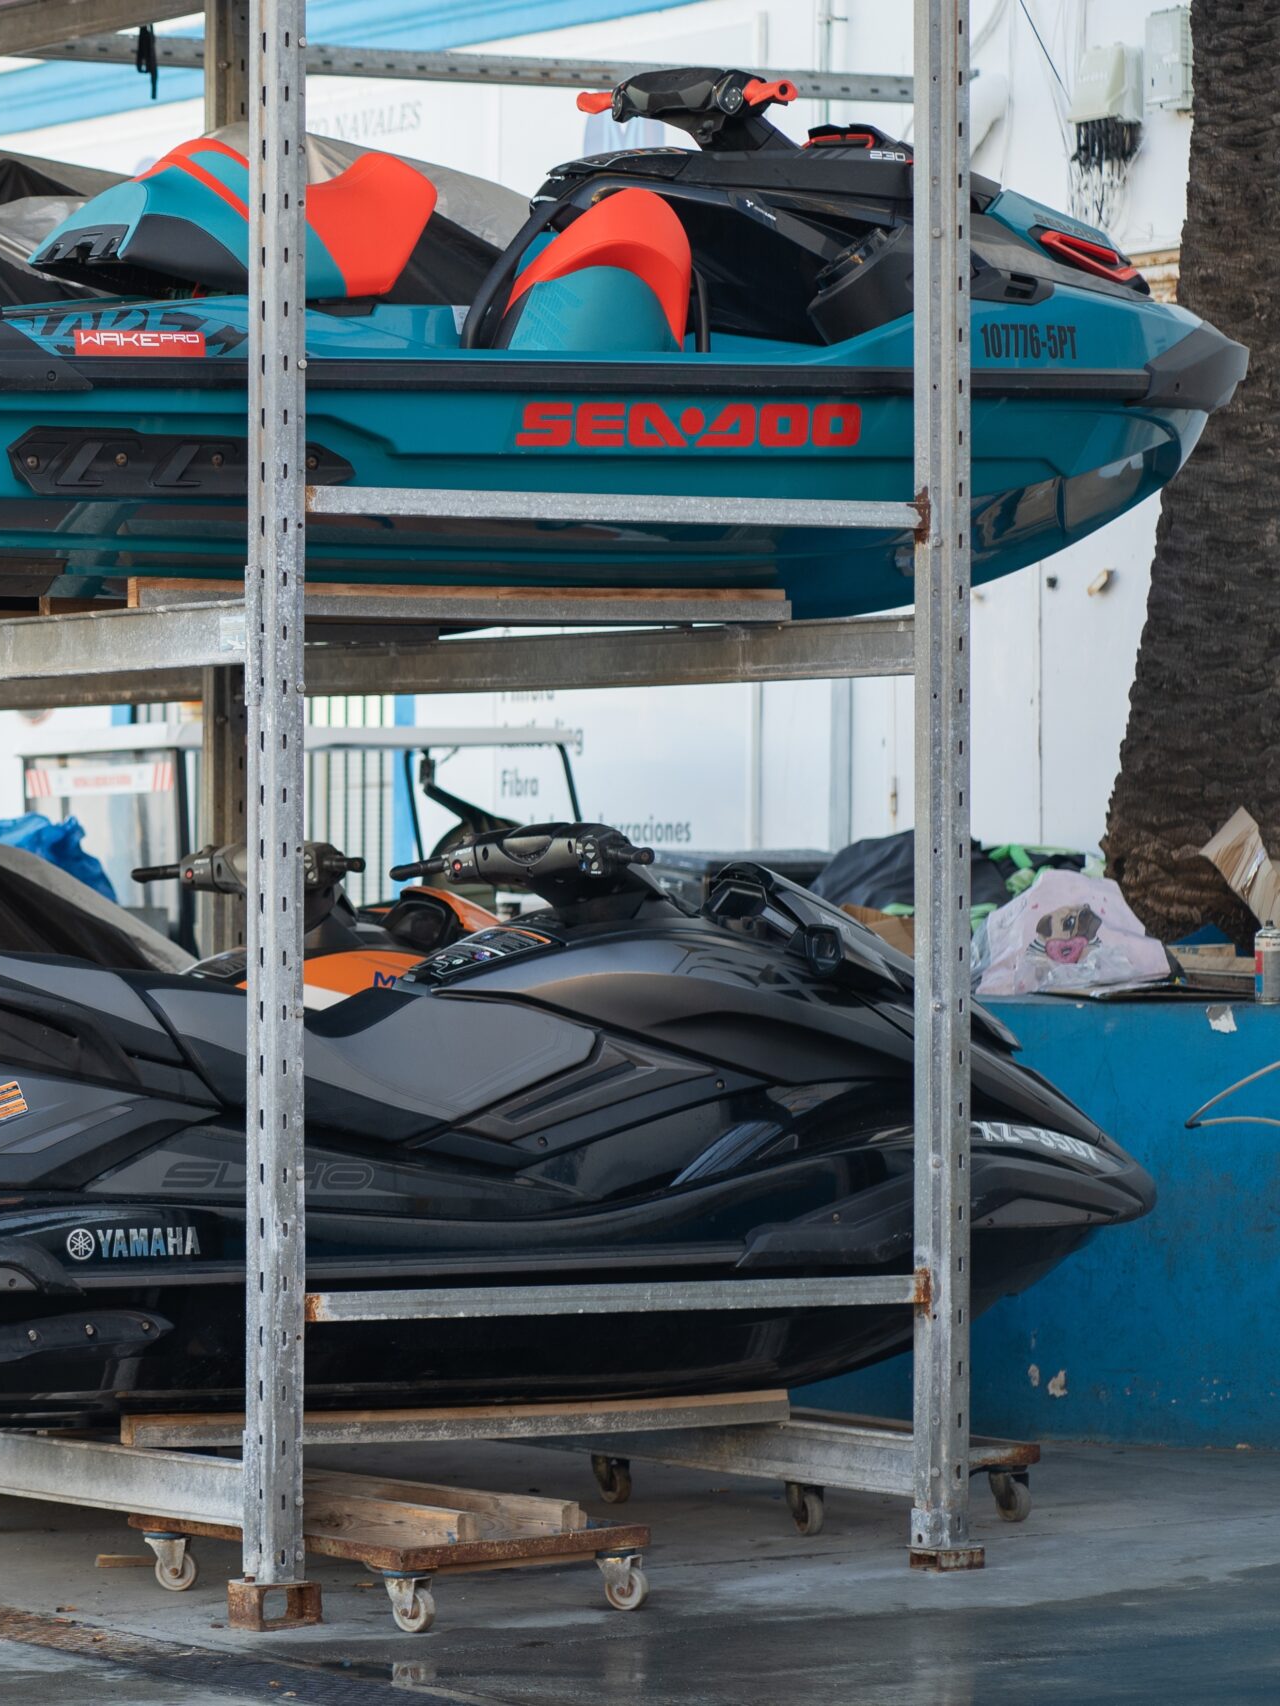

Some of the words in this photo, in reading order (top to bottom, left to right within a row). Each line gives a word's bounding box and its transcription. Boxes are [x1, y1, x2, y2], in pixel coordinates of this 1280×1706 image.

[869, 150, 906, 162] 230
[981, 323, 1077, 359] 107776-5PT
[501, 768, 539, 797] Fibra
[96, 1226, 201, 1259] YAMAHA
